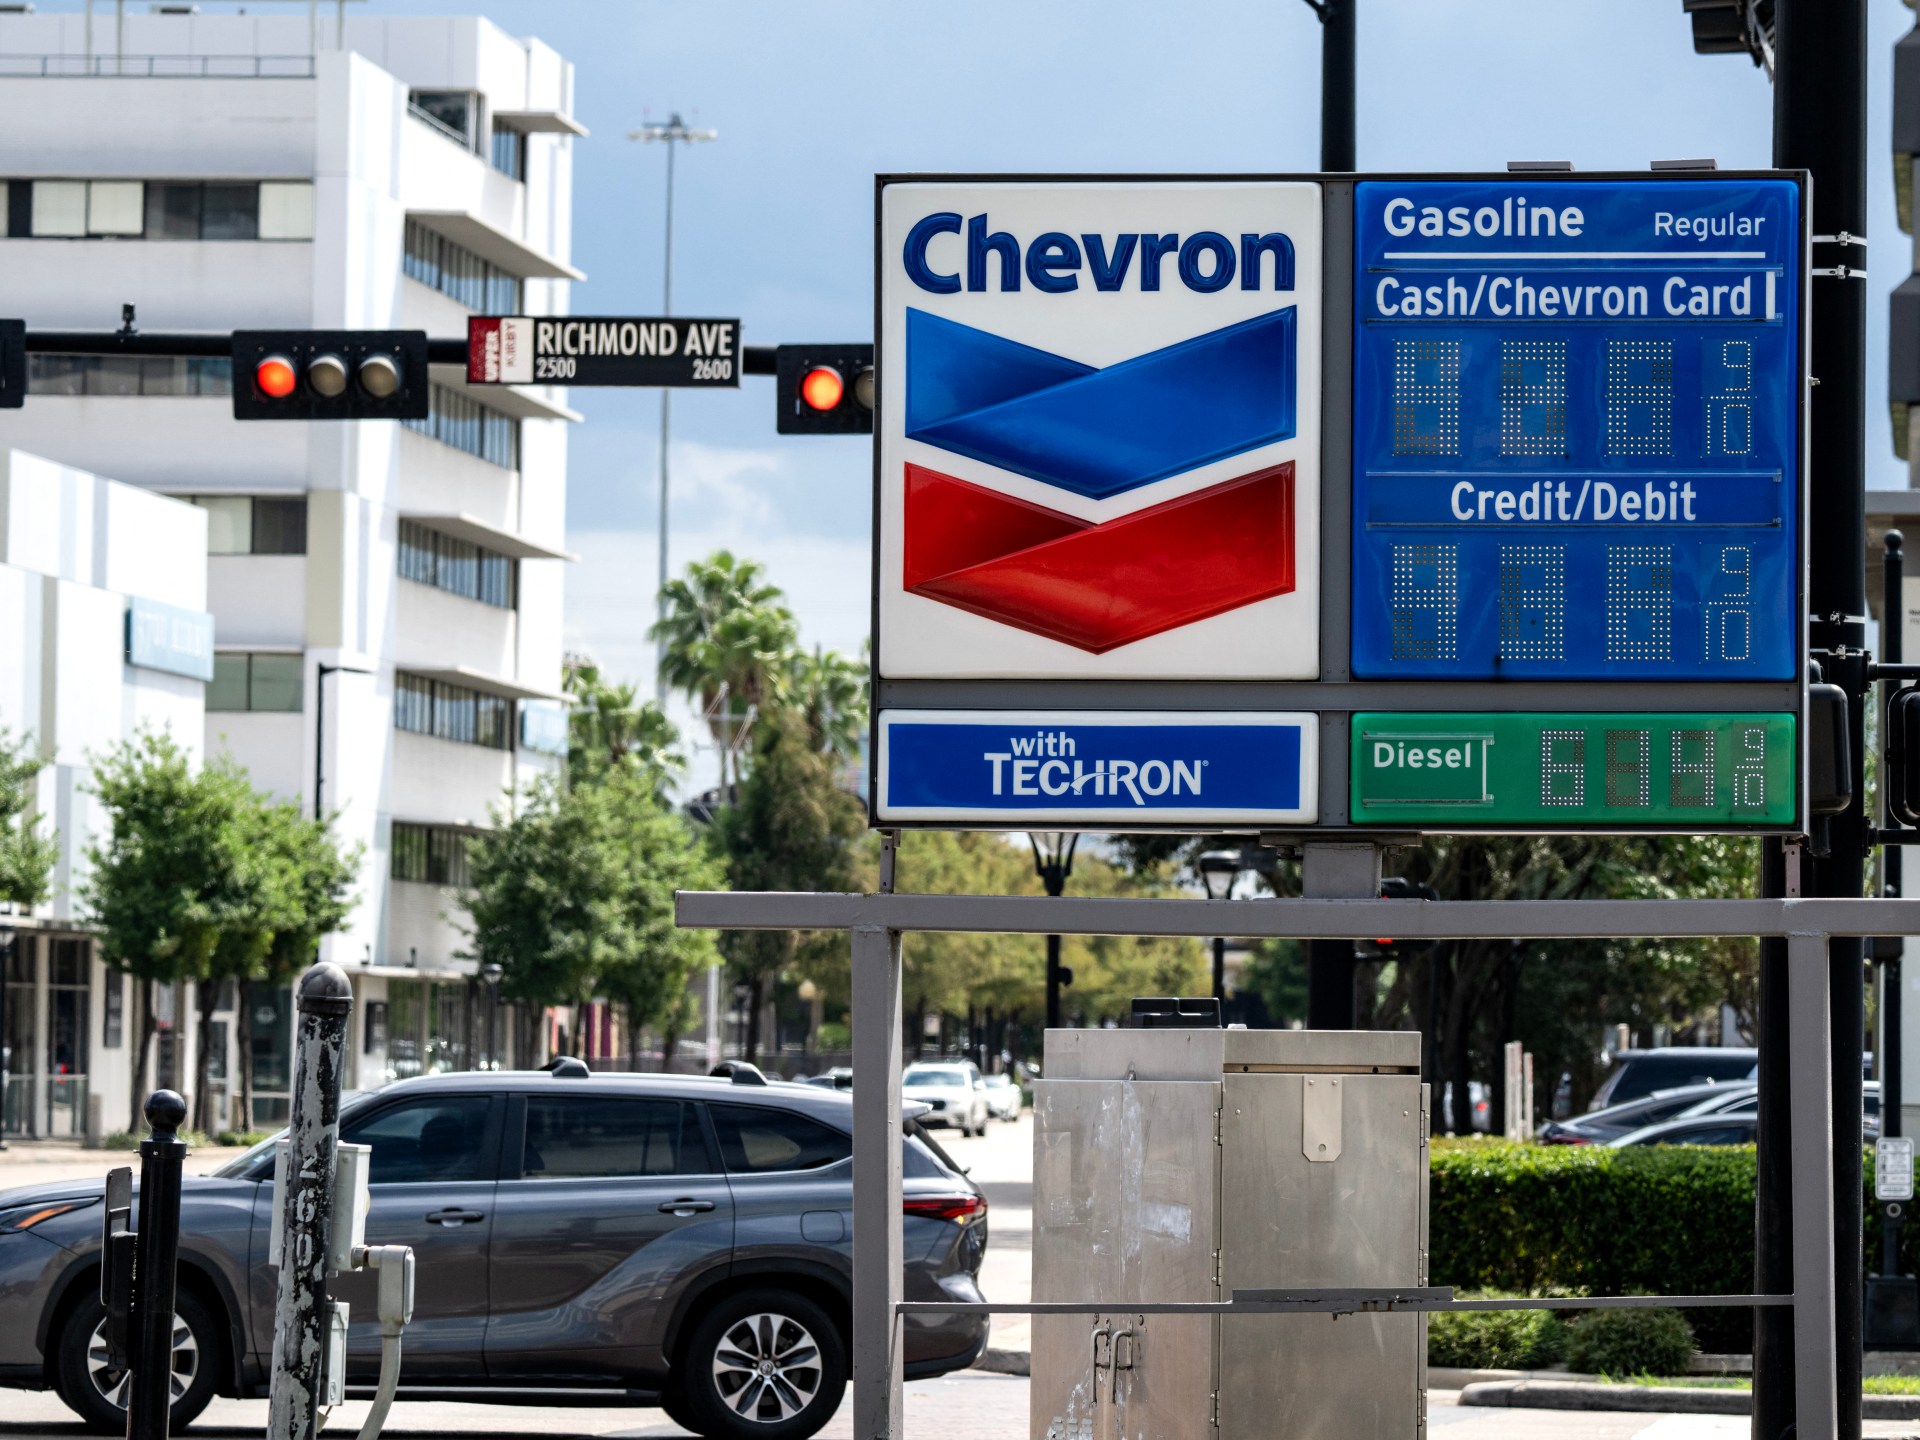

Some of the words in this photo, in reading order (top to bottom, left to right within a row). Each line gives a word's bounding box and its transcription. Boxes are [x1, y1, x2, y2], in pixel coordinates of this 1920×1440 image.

[1384, 196, 1585, 237] Gasoline
[1654, 212, 1766, 242] Regular
[903, 212, 1296, 294] Chevron
[1375, 275, 1648, 316] Cash/Chevron
[1663, 275, 1751, 316] Card
[485, 330, 500, 382] UPPER
[536, 321, 677, 356] RICHMOND
[684, 323, 733, 356] AVE
[536, 357, 577, 379] 2500
[692, 359, 733, 380] 2600
[1450, 480, 1697, 522] Credit/Debit
[1010, 731, 1075, 757] with
[1373, 742, 1471, 768] Diesel
